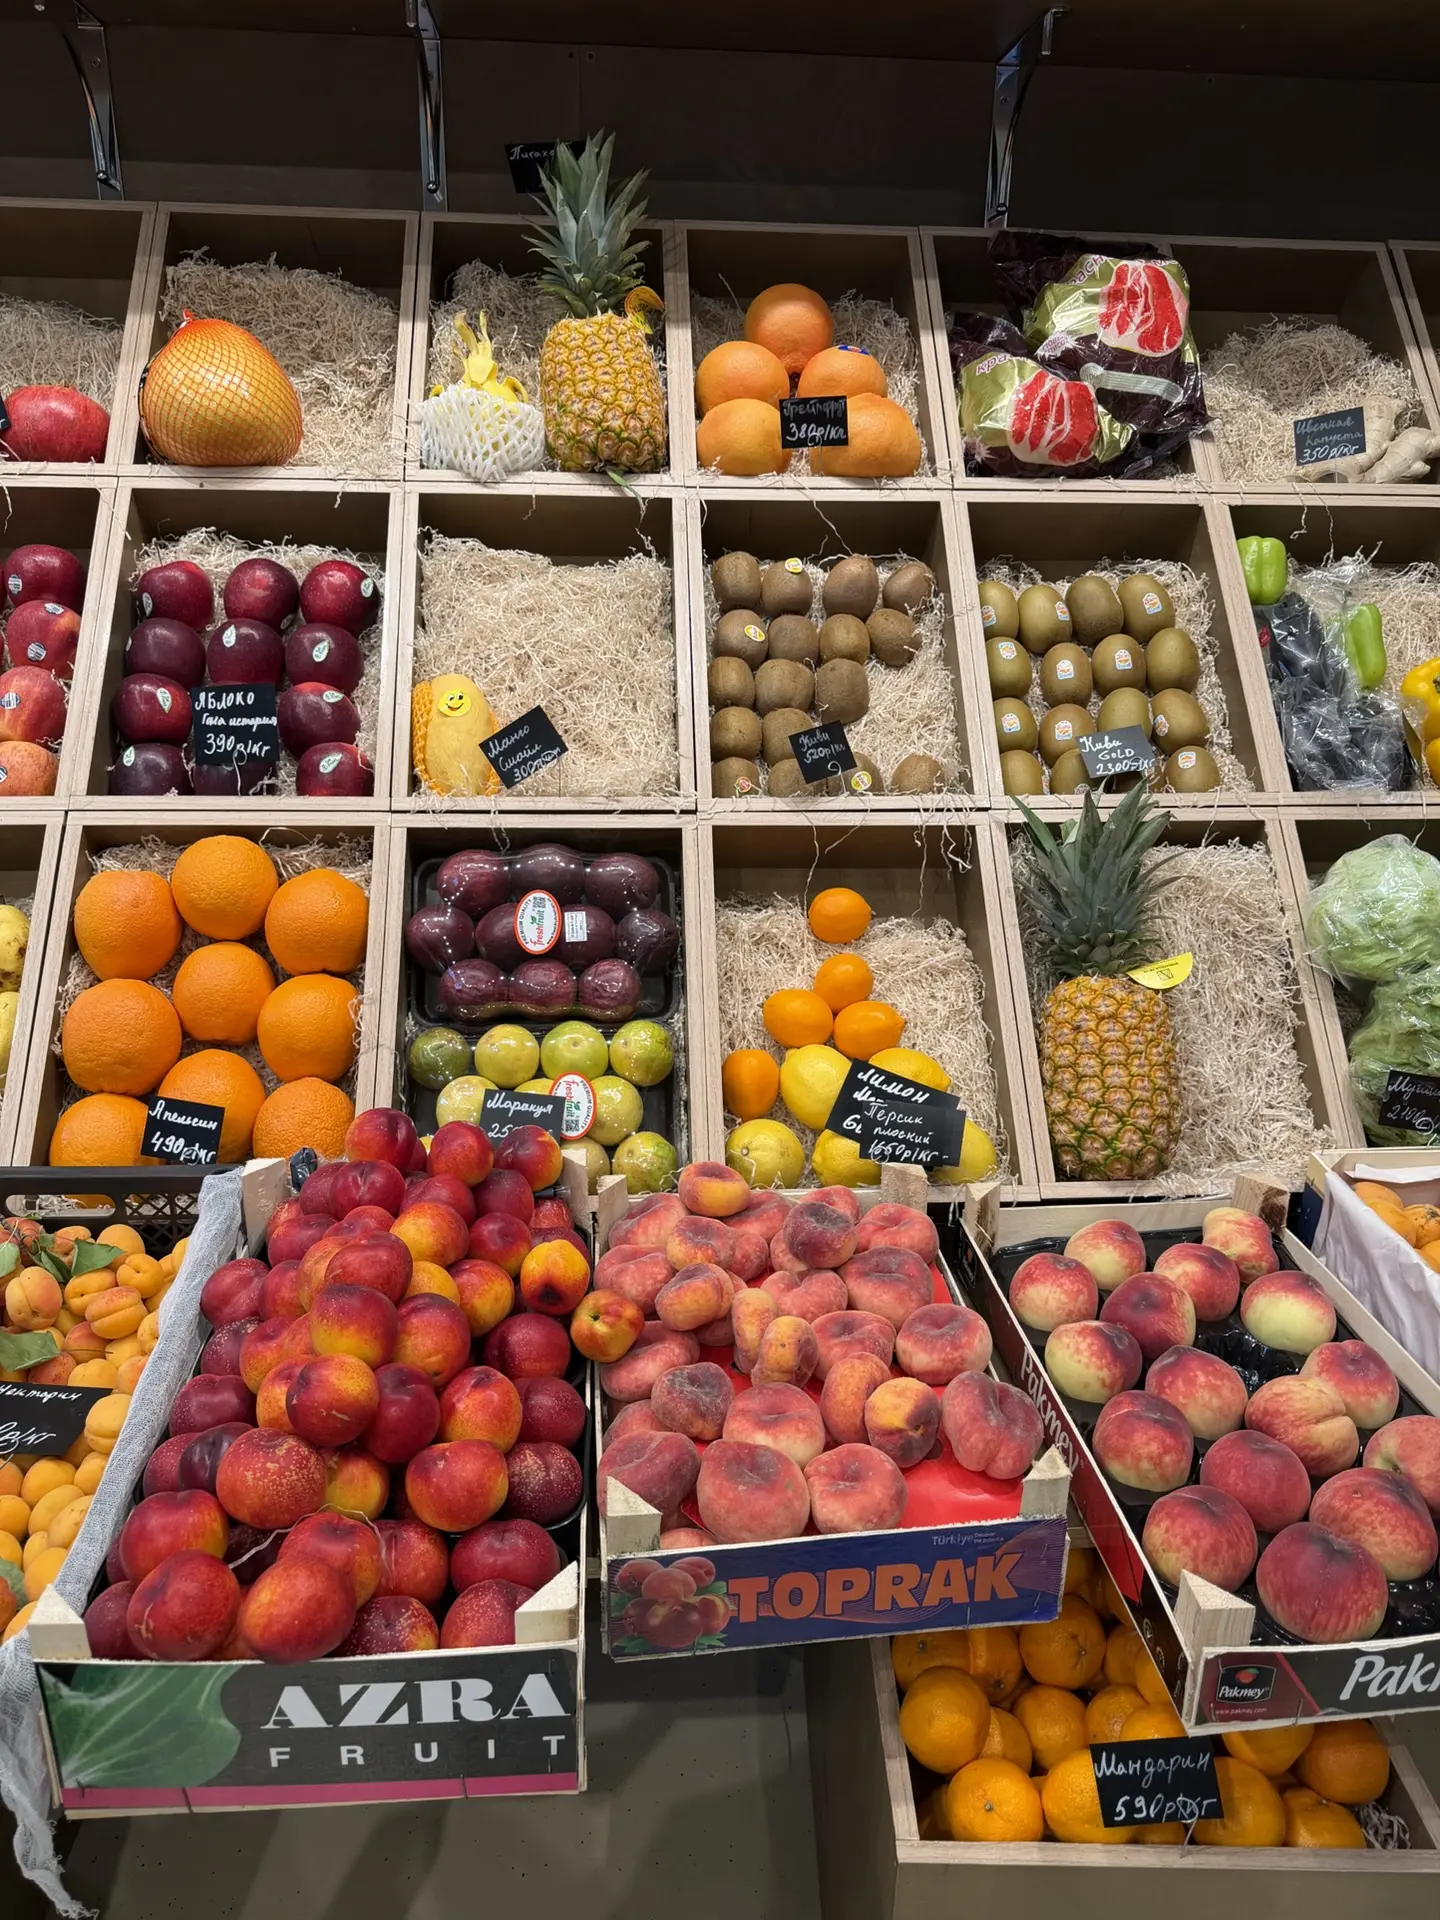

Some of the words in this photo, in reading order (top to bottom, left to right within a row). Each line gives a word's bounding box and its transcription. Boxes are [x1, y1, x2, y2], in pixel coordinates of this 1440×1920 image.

[488, 725, 530, 758] Манго
[1080, 736, 1122, 752] Киви
[518, 898, 532, 920] QUALITY
[149, 1099, 218, 1131] Апельсин
[581, 1105, 592, 1129] QUALITY
[864, 1102, 923, 1126] Персик
[1020, 1345, 1079, 1473] Pakmey
[728, 1551, 1024, 1623] TOPRAK
[1218, 1685, 1265, 1699] Pakmey
[1339, 1652, 1440, 1701] Pak
[260, 1672, 571, 1729] AZRA
[269, 1734, 566, 1768] FRUIT
[1094, 1751, 1211, 1789] Мандарин
